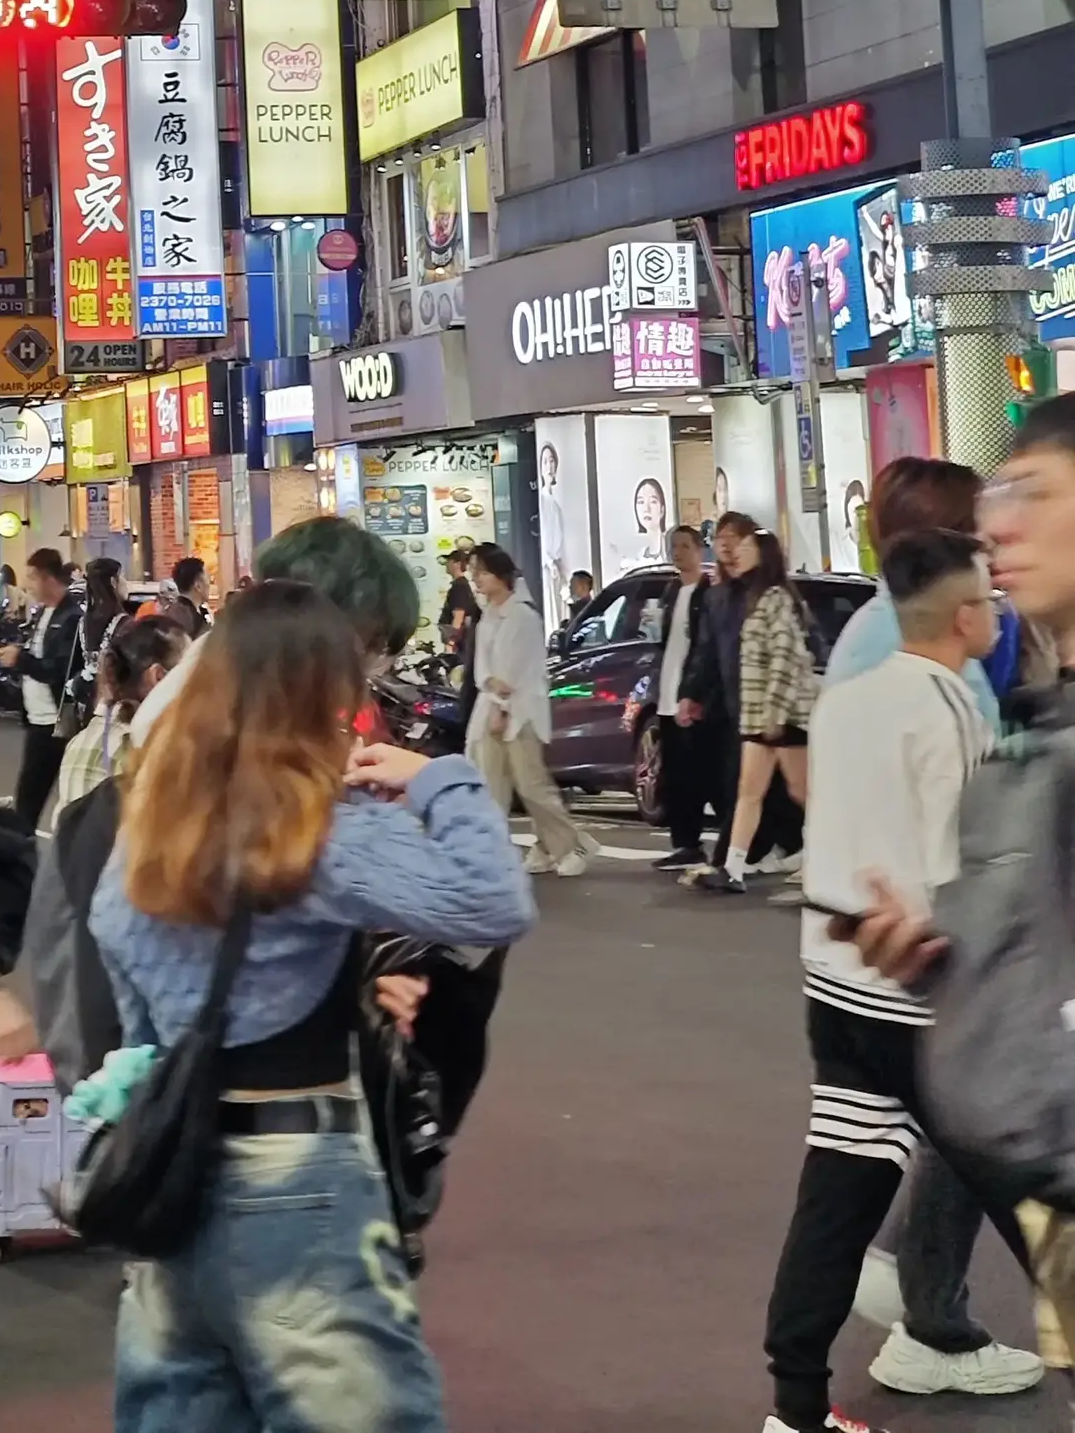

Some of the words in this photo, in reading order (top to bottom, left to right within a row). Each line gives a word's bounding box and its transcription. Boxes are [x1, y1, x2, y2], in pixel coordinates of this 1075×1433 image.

[377, 71, 416, 115] PEPPER
[418, 51, 458, 96] LUNCH
[256, 104, 332, 122] PEPPER
[62, 40, 124, 244] すき家
[258, 126, 332, 142] LUNCH
[748, 102, 867, 188] FRIDAYS
[154, 72, 198, 268] 豆腐鍋之家
[68, 256, 100, 328] 咖哩
[105, 256, 131, 327] 牛丼
[19, 342, 36, 359] H
[636, 320, 695, 357] 情趣
[70, 345, 101, 367] 24
[104, 344, 136, 356] OPEN
[104, 357, 137, 367] HOURS
[27, 380, 62, 391] HOLIC
[388, 460, 437, 473] PEPPER
[442, 459, 491, 472] LUNCH
